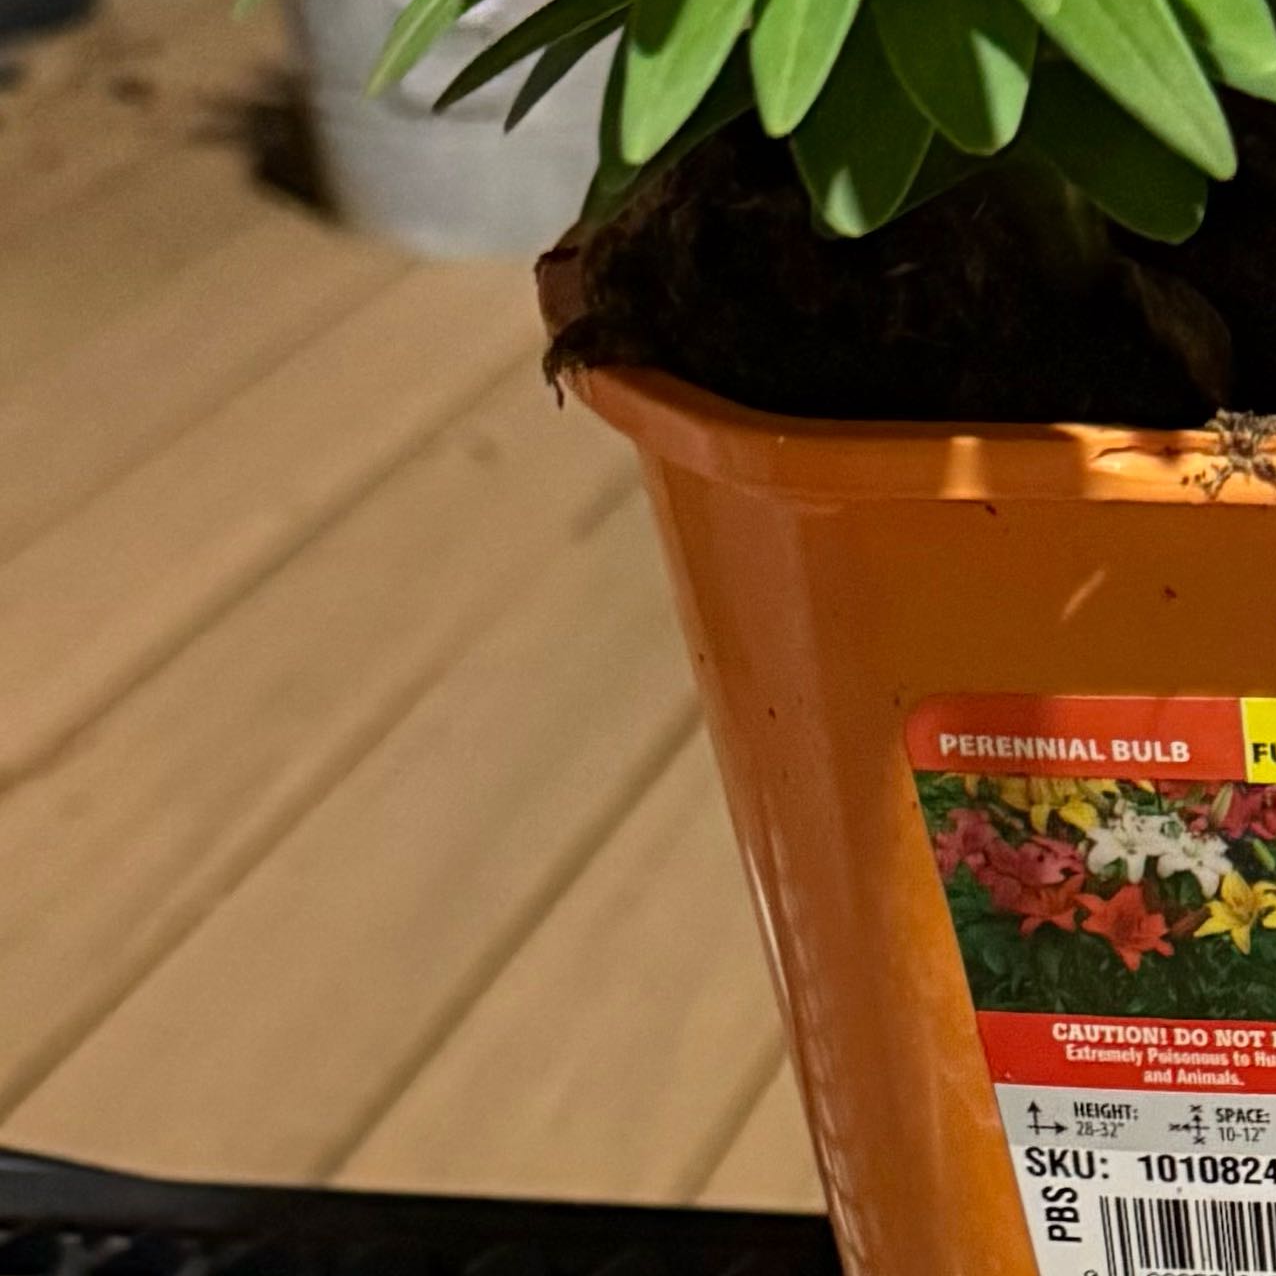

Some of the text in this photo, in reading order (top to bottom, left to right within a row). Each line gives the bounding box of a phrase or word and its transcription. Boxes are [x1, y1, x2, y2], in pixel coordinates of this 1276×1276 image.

[940, 733, 1190, 762] PERENNIAL BULB
[1052, 1023, 1167, 1045] CAUTION!
[1173, 1028, 1208, 1046] DO
[1214, 1029, 1266, 1047] NOT
[1065, 1043, 1143, 1066] Extremely
[1148, 1047, 1229, 1066] Poisonous
[1232, 1051, 1250, 1066] to
[1143, 1068, 1172, 1084] and
[1073, 1101, 1139, 1121] HEIGHT:
[1215, 1108, 1271, 1124] SPACE:
[1024, 1146, 1109, 1180] SKU:
[1041, 1186, 1083, 1243] PBS
